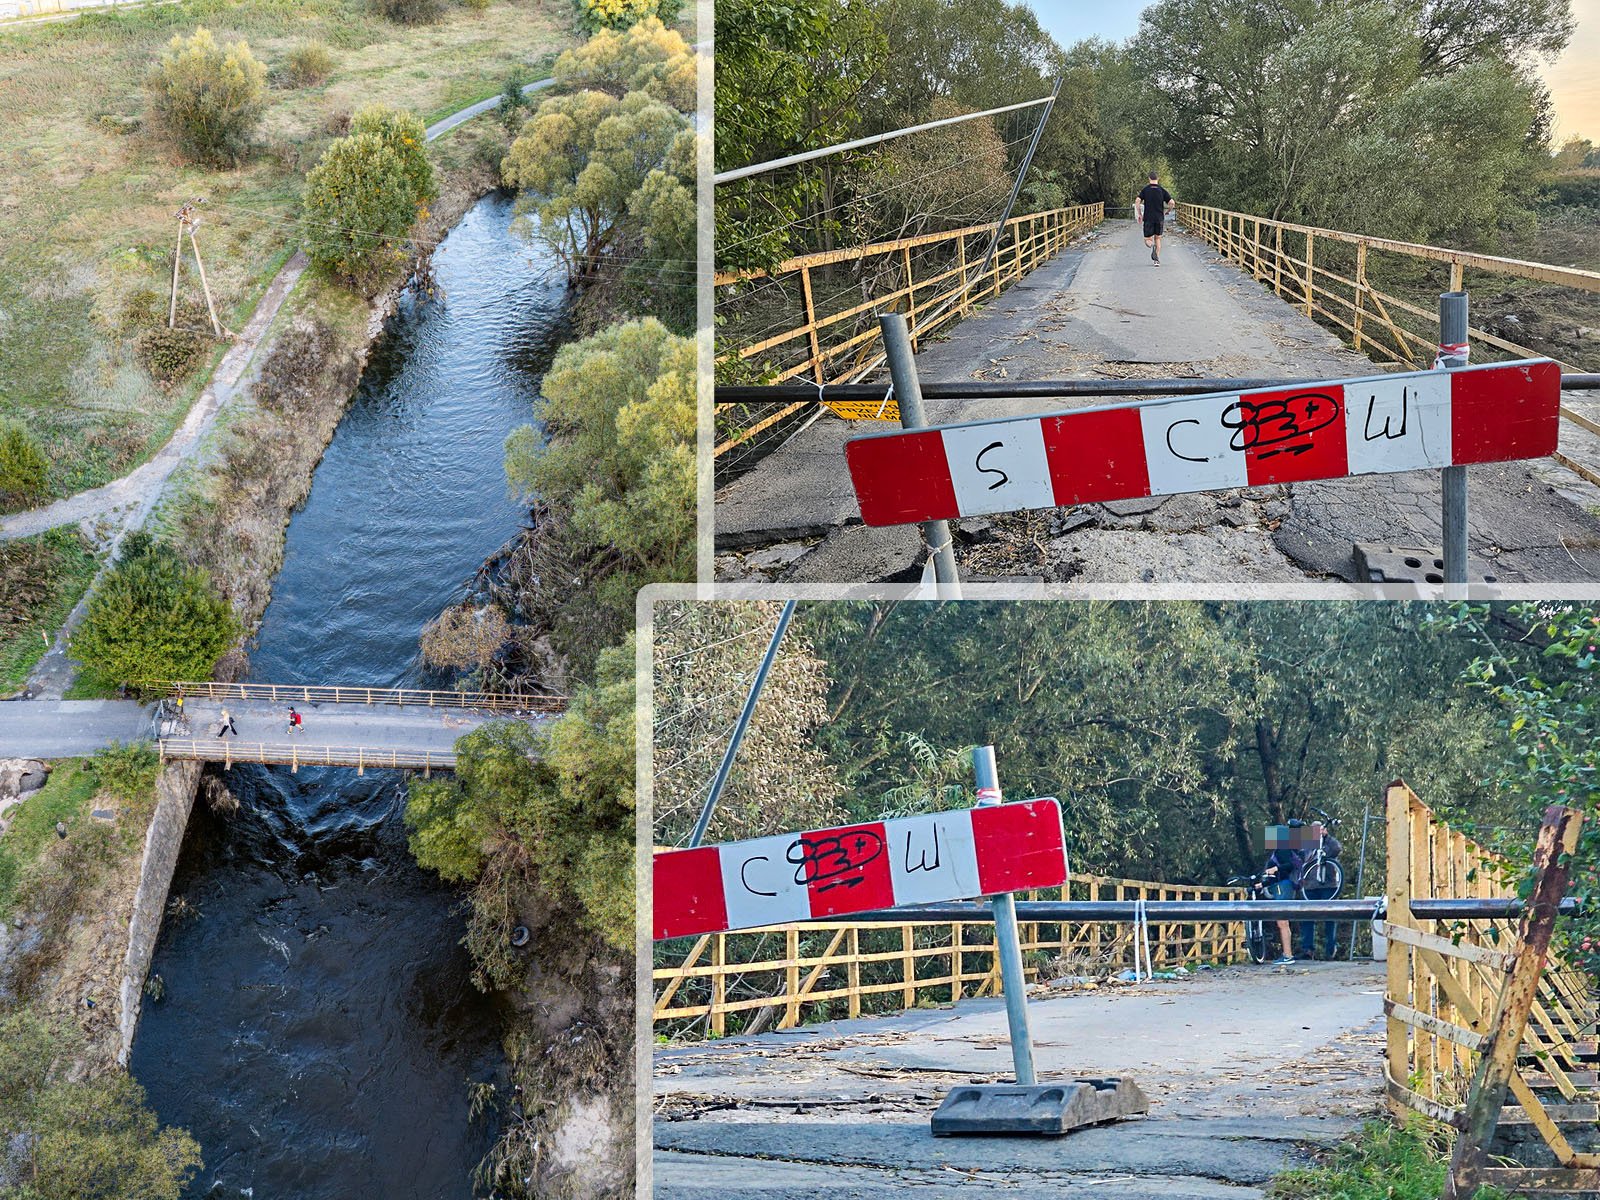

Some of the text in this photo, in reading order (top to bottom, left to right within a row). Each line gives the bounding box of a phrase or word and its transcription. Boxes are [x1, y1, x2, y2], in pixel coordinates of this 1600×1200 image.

[975, 441, 1009, 490] S
[1166, 419, 1209, 463] C
[1364, 386, 1407, 441] W
[741, 856, 777, 896] C
[905, 822, 940, 873] W
